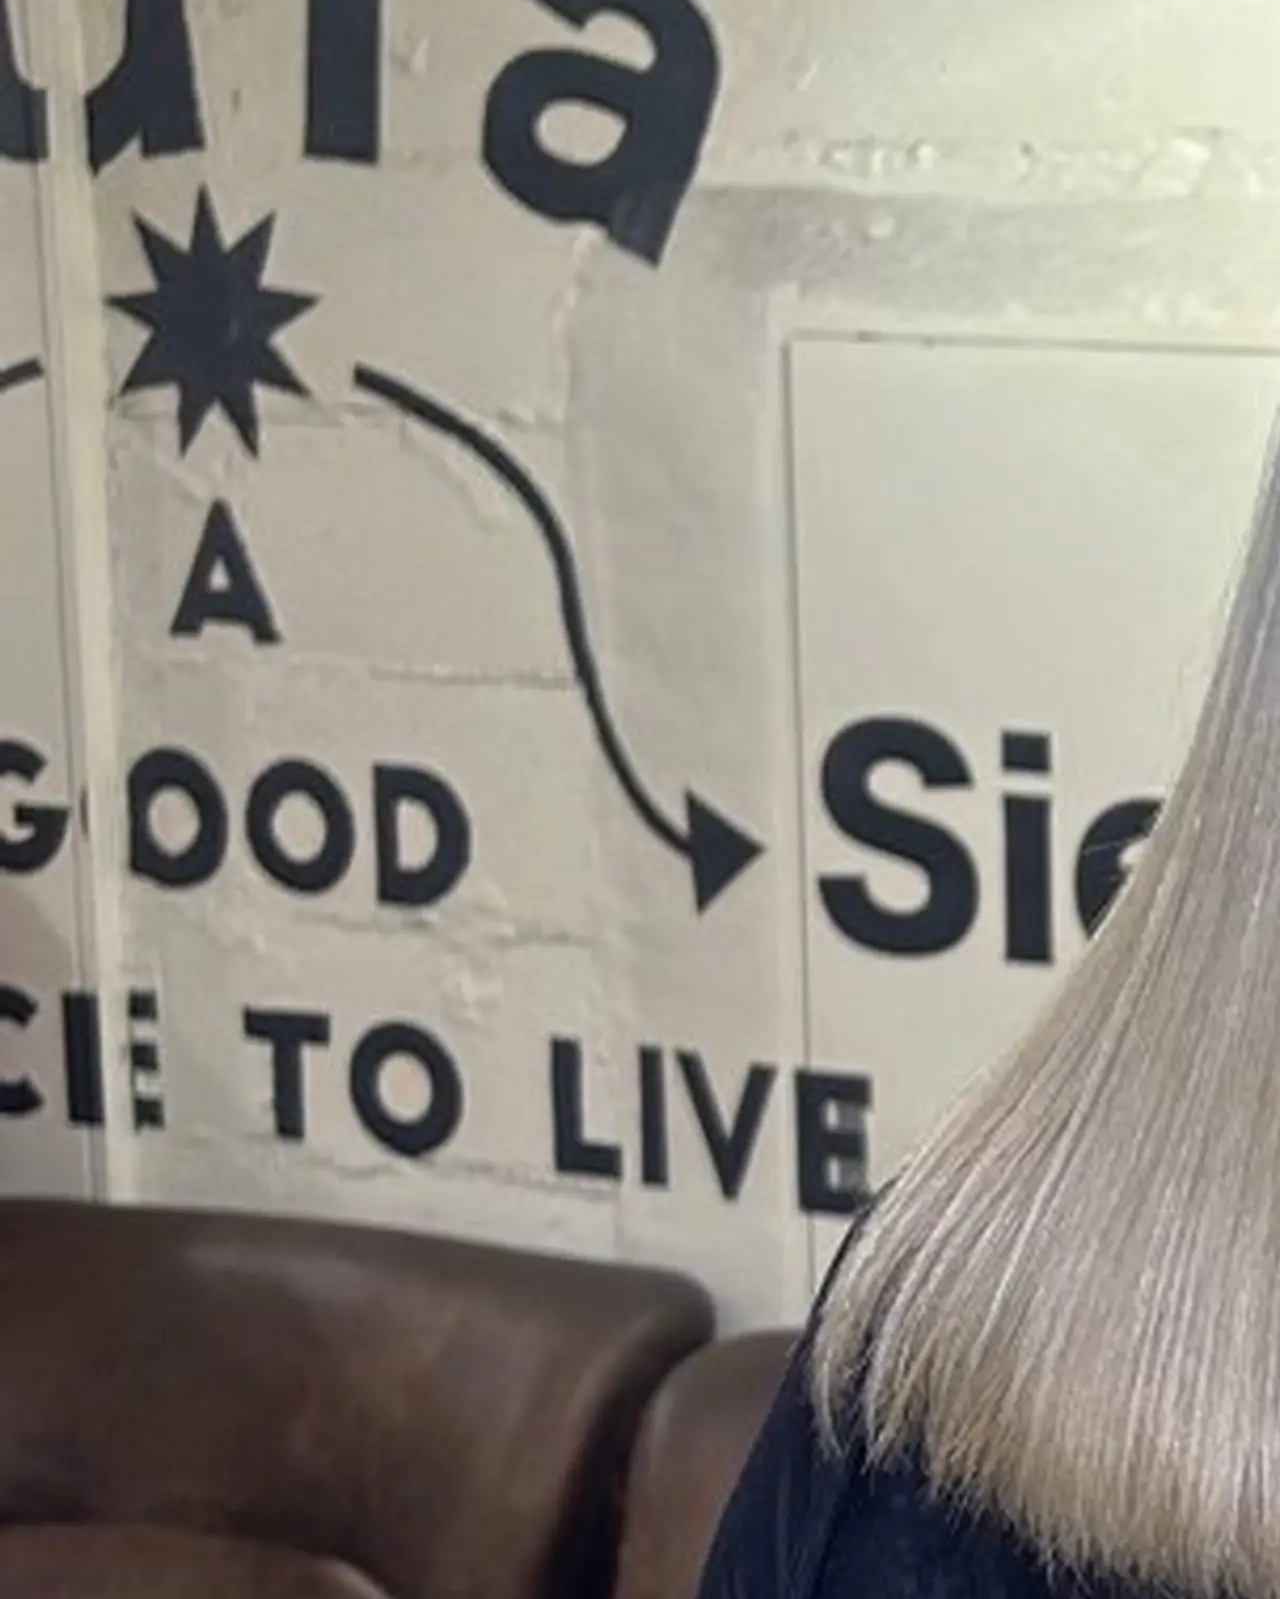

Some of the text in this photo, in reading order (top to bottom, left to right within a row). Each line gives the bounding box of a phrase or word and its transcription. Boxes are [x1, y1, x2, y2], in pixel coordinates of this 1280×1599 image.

[170, 500, 280, 645] A
[0, 740, 470, 908] GOOD
[242, 1007, 463, 1160] TO
[550, 1038, 873, 1215] LIVE
